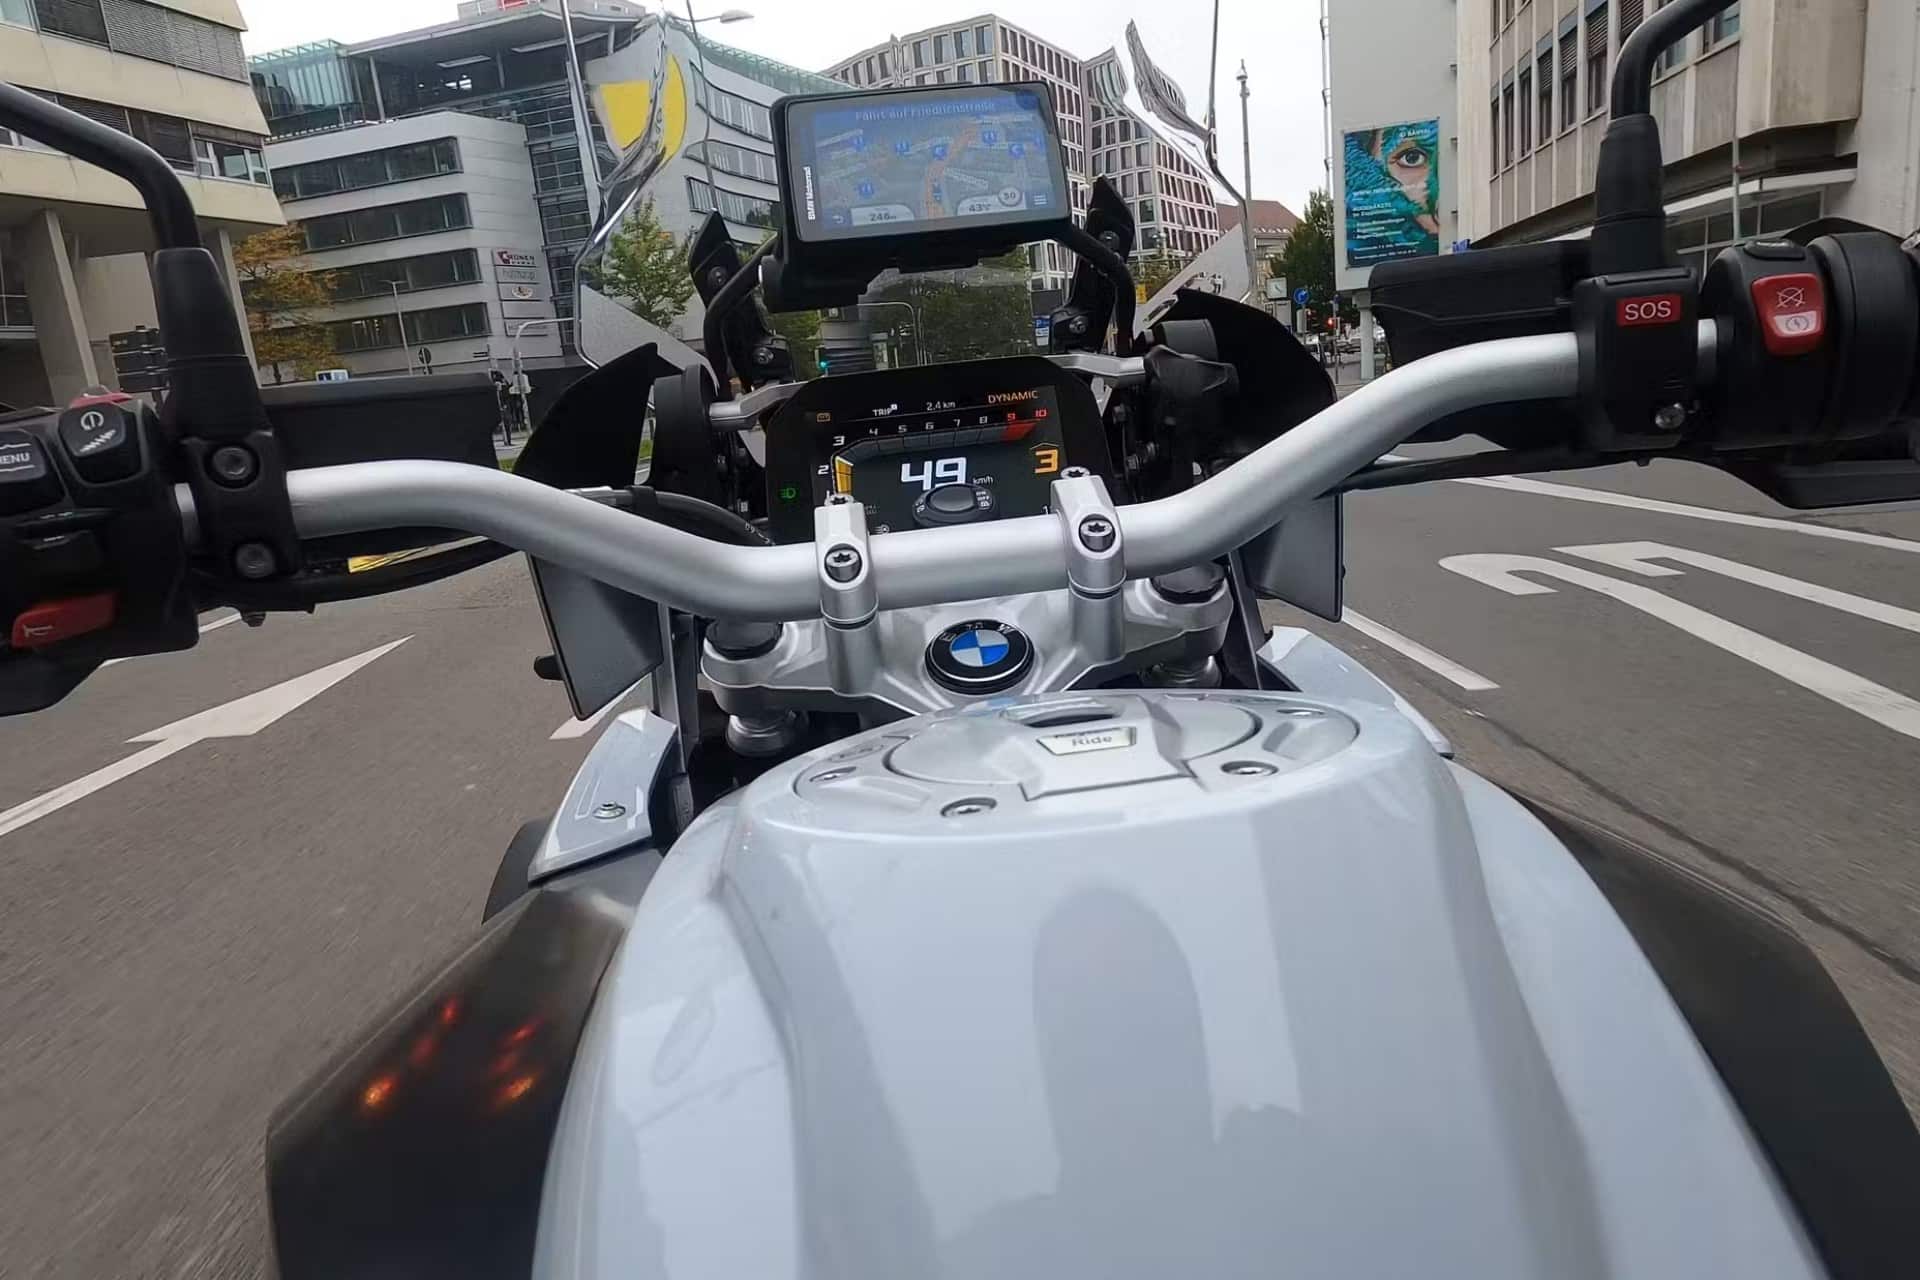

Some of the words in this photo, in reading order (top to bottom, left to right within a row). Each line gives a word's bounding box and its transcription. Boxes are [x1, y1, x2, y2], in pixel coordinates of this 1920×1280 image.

[1624, 300, 1672, 321] SOS
[988, 390, 1040, 404] DYNAMIC
[872, 408, 892, 417] TRIP
[926, 401, 942, 411] 2.4
[832, 435, 846, 447] 3
[868, 427, 879, 436] 4
[898, 424, 908, 434] 5
[925, 421, 935, 430] 6
[953, 418, 961, 428] 7
[979, 415, 988, 424] 8
[1007, 412, 1016, 421] 9
[1035, 408, 1047, 417] 10
[0, 451, 30, 465] ENU
[1034, 448, 1060, 474] 3
[817, 464, 830, 476] 2
[900, 456, 967, 491] 49
[972, 475, 994, 485] km/h
[1071, 735, 1113, 746] Ride
